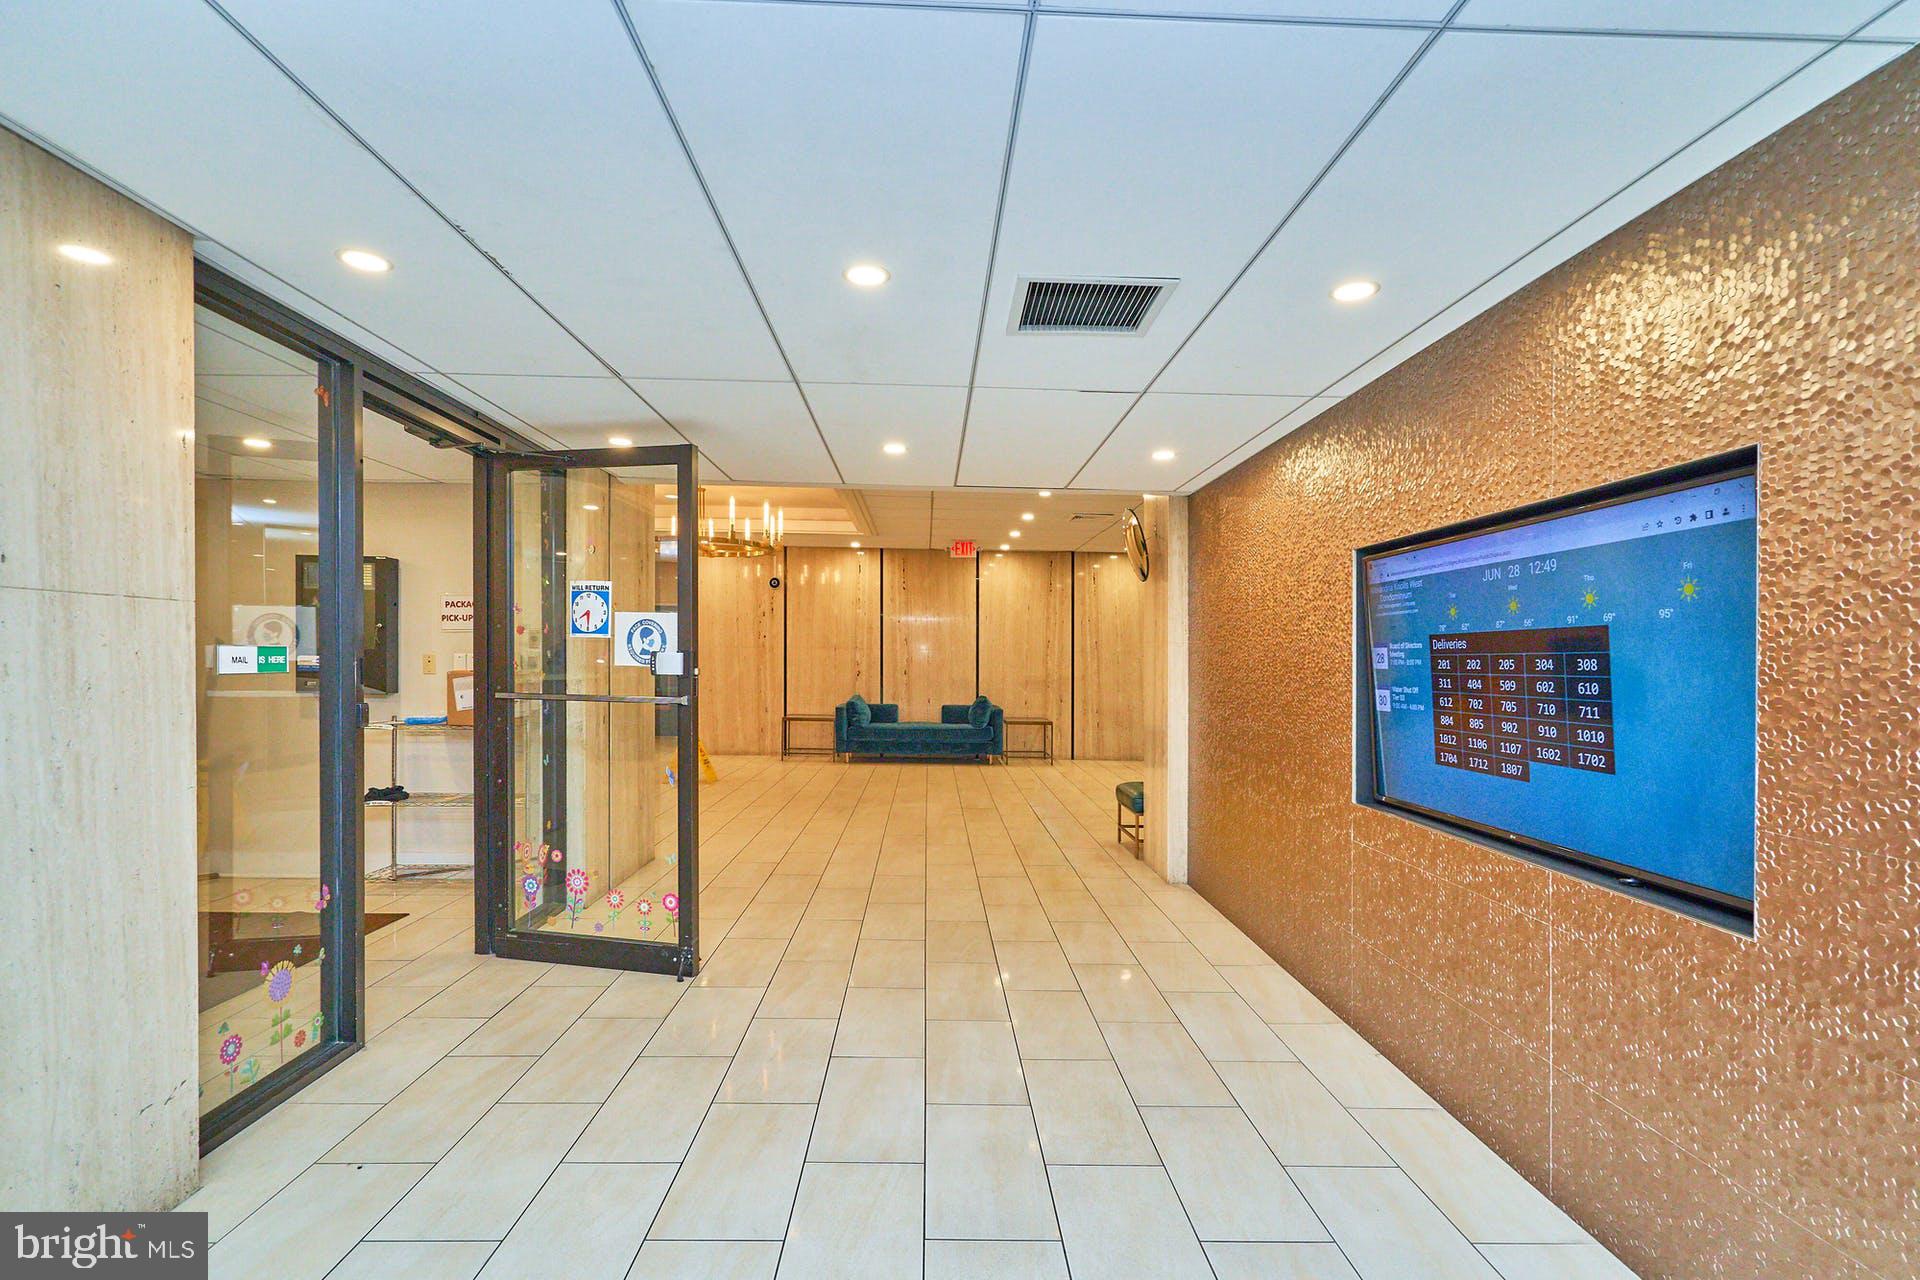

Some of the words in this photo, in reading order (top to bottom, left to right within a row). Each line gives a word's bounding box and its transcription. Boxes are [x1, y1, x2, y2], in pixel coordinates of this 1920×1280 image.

[955, 541, 974, 556] EXIT
[1482, 568, 1501, 581] JUN
[1508, 564, 1520, 578] 28
[1528, 558, 1557, 575] 12:49
[1683, 561, 1693, 569] Fri
[441, 614, 474, 622] PICK-UP
[1659, 608, 1674, 618] 95°
[1433, 639, 1467, 650] Deliveries
[231, 656, 248, 664] MAIL
[258, 656, 265, 664] IS
[268, 656, 286, 664] HERE
[1376, 653, 1385, 664] 28
[1438, 660, 1450, 669] 201
[1466, 660, 1481, 670] 202
[1499, 660, 1515, 670] 205
[1535, 659, 1554, 670] 304
[1577, 659, 1597, 671] 308
[1439, 678, 1451, 689] 311
[1467, 680, 1482, 690] 404
[1500, 680, 1516, 691] 509
[1536, 681, 1555, 693] 602
[1578, 683, 1599, 695] 610
[1378, 695, 1388, 706] 30
[1439, 697, 1453, 707] 612
[1468, 699, 1483, 710] 702
[1501, 701, 1517, 712] 705
[1537, 704, 1556, 715] 710
[1579, 706, 1600, 719] 711
[1440, 716, 1454, 726] 804
[1469, 718, 1484, 729] 805
[1502, 722, 1518, 734] 902
[1538, 725, 1557, 738] 910
[1577, 729, 1605, 744] 1010
[1439, 734, 1457, 746] 1012
[1468, 737, 1488, 750] 1106
[1500, 742, 1522, 755] 1107
[1536, 747, 1561, 761] 1602
[1577, 752, 1606, 768] 1702
[1440, 752, 1458, 764] 1704
[1469, 757, 1488, 770] 1712
[1501, 763, 1523, 776] 1807
